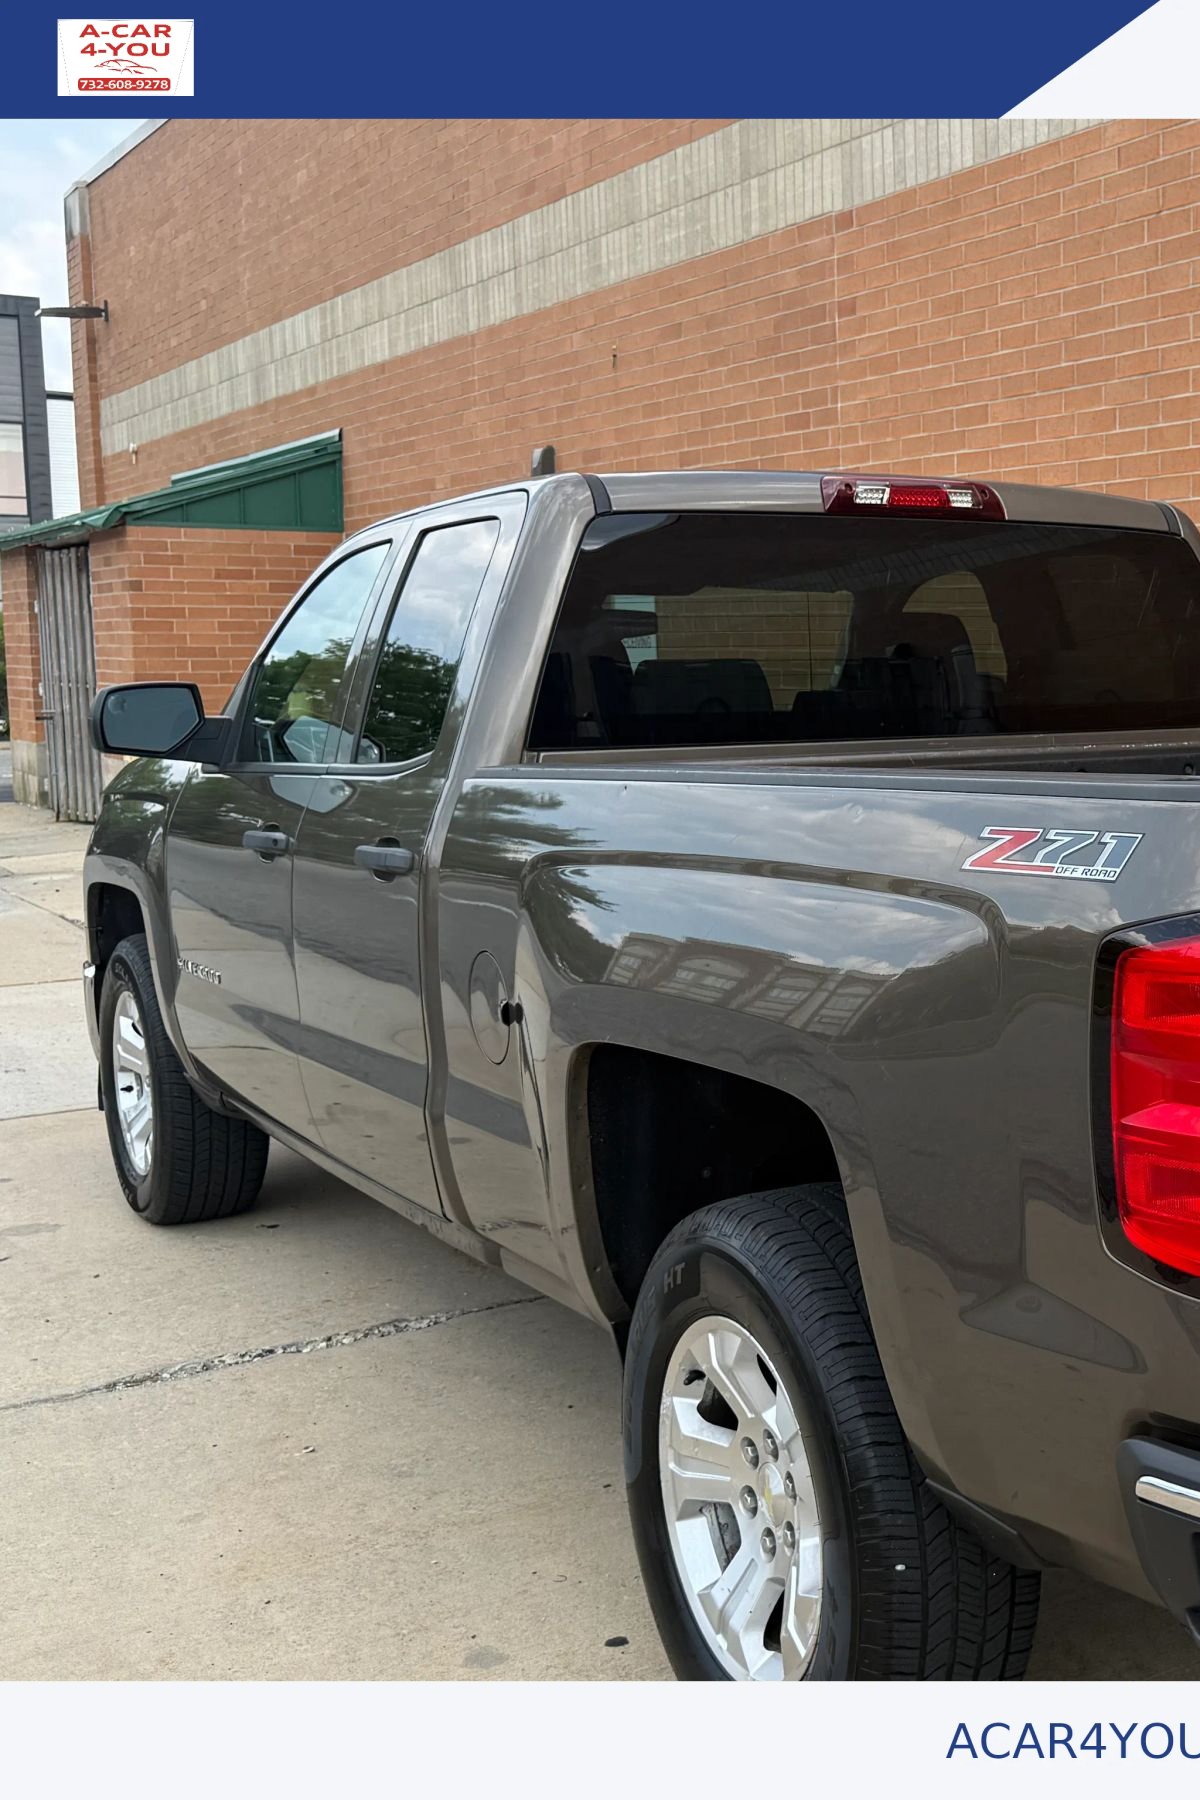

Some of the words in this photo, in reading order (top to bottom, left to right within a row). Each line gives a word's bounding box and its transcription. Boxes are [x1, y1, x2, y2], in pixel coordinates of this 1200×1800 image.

[960, 825, 1144, 883] Z71
[1055, 866, 1078, 875] OFF
[1081, 868, 1118, 879] ROAD
[662, 1262, 686, 1294] HT
